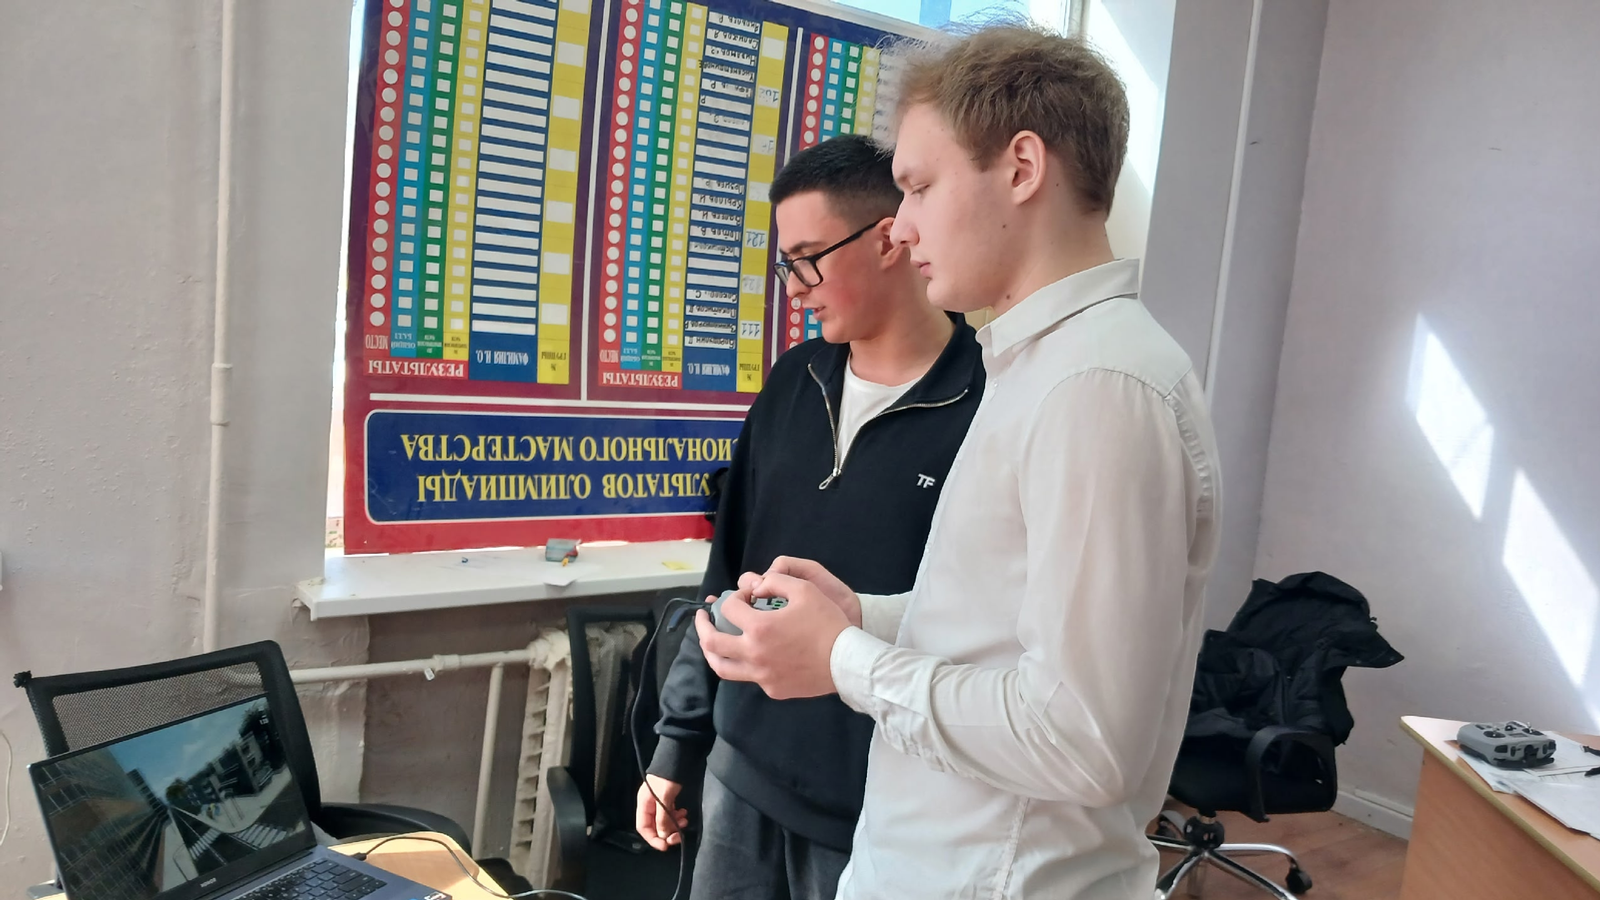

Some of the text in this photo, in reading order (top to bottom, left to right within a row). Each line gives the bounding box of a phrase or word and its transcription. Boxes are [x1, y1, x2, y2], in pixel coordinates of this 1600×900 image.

[745, 231, 765, 247] 121
[741, 322, 759, 337] 111
[365, 334, 388, 349] МЕСТО
[493, 350, 529, 364] ФАМИЛИЯ
[541, 351, 567, 360] ГРУППЫ
[599, 349, 619, 363] МЕСТО
[368, 359, 464, 377] РЕЗУЛЬТАТЫ
[601, 371, 678, 387] РЕЗУЛЬТАТЫ
[400, 433, 737, 461] ИОНАЛЬНОГО МАСТЕРСТВА
[416, 469, 591, 501] ОЛИМПИАДЫ
[917, 473, 935, 488] TF
